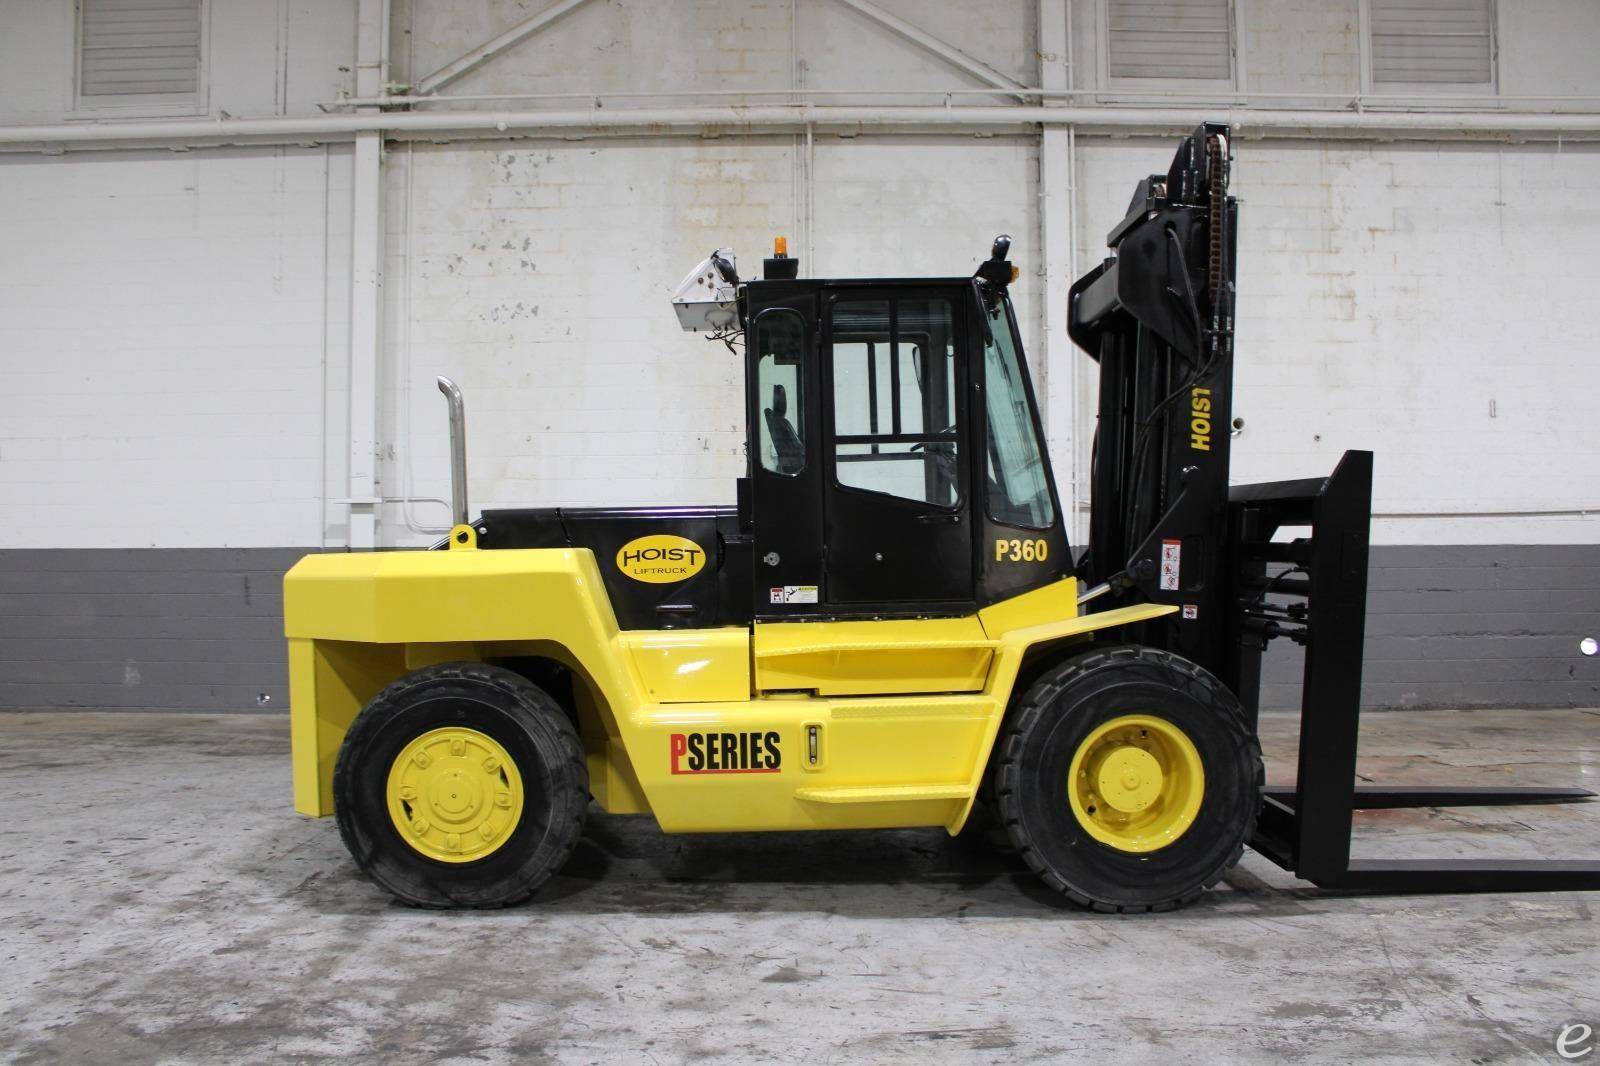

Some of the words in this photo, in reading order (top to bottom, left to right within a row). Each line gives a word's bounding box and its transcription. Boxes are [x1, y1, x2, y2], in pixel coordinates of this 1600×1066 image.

[1191, 387, 1211, 451] HOIST
[623, 548, 700, 566] HOIST
[995, 539, 1048, 562] P360
[633, 567, 687, 575] LIFTRUCK
